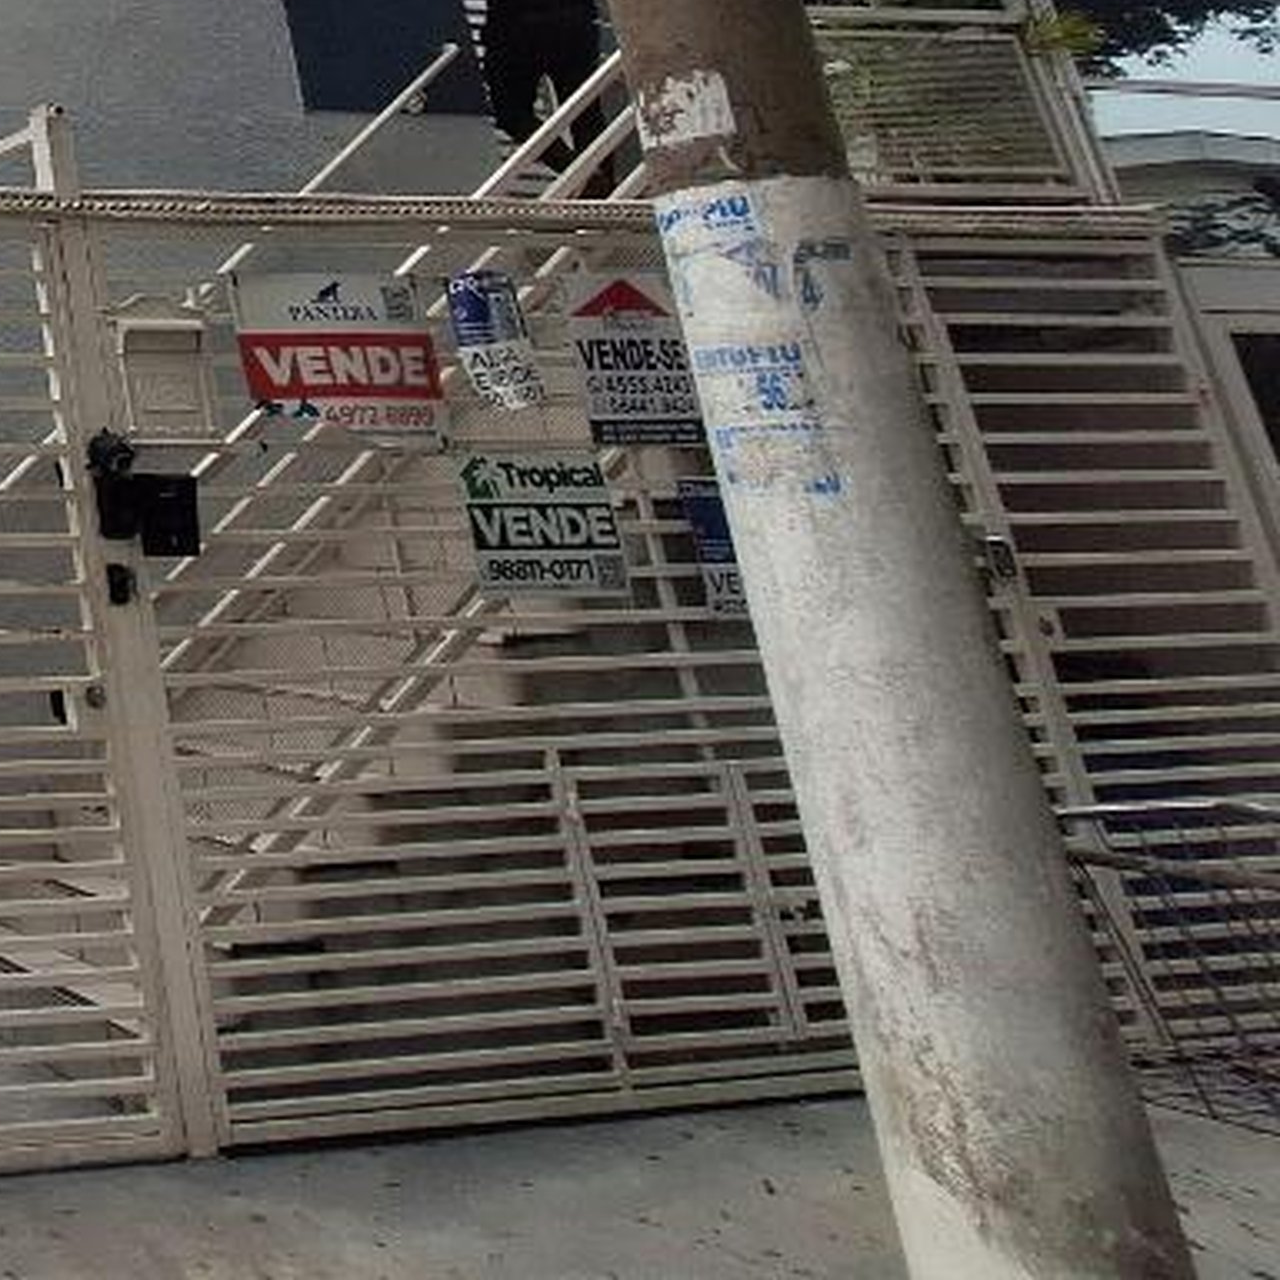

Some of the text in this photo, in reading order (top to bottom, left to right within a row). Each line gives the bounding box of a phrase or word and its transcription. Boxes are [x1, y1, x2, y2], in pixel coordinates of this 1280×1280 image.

[252, 345, 429, 386] VENDE
[496, 461, 606, 494] Tropical
[472, 506, 618, 546] VENDE
